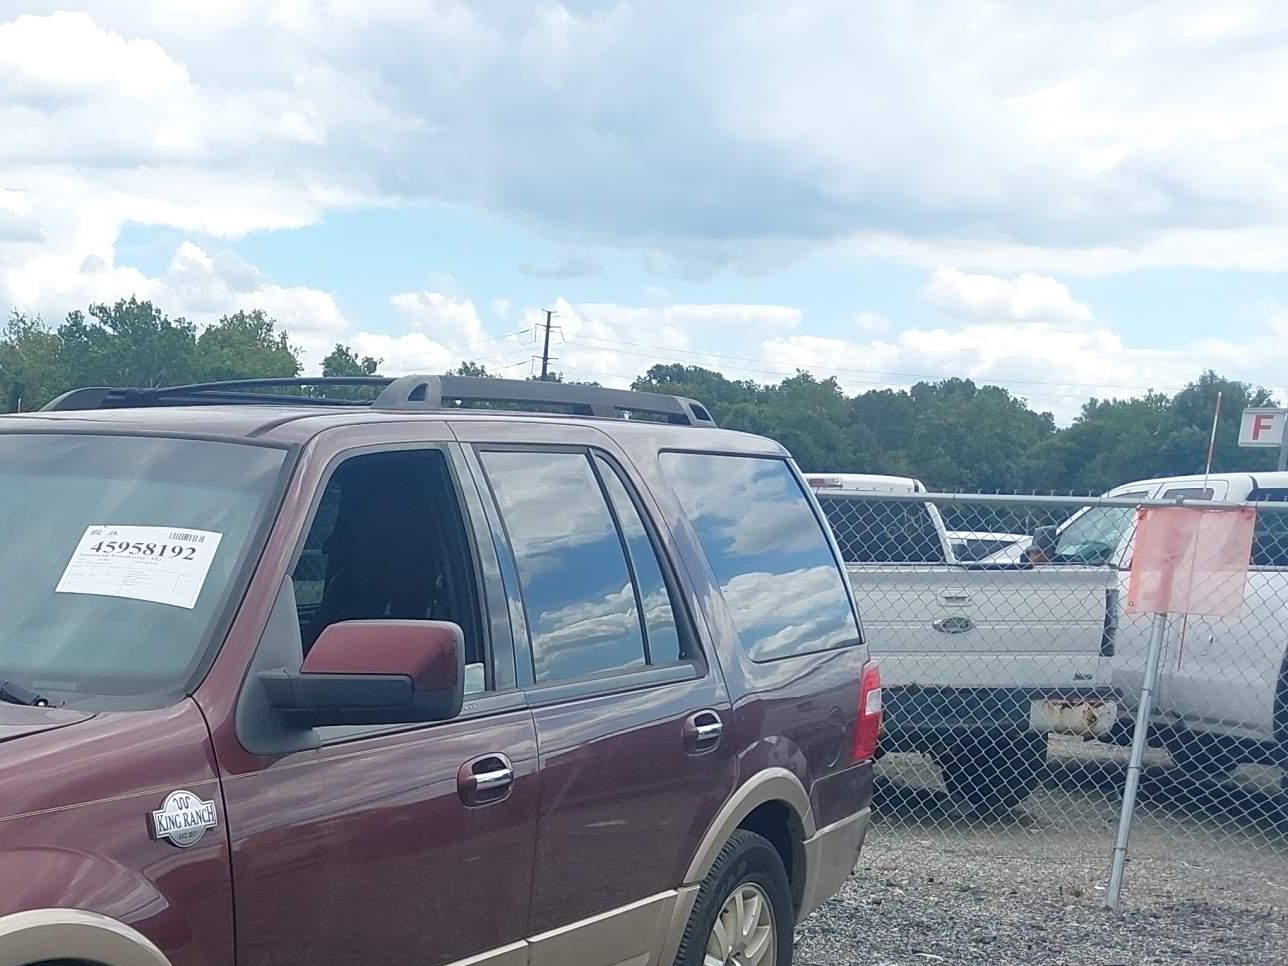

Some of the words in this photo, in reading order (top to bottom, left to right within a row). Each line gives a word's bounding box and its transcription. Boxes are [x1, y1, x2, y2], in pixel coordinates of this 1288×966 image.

[1252, 415, 1274, 440] F
[90, 540, 197, 561] 45958192
[157, 814, 182, 832] KING
[183, 805, 215, 827] RANCH
